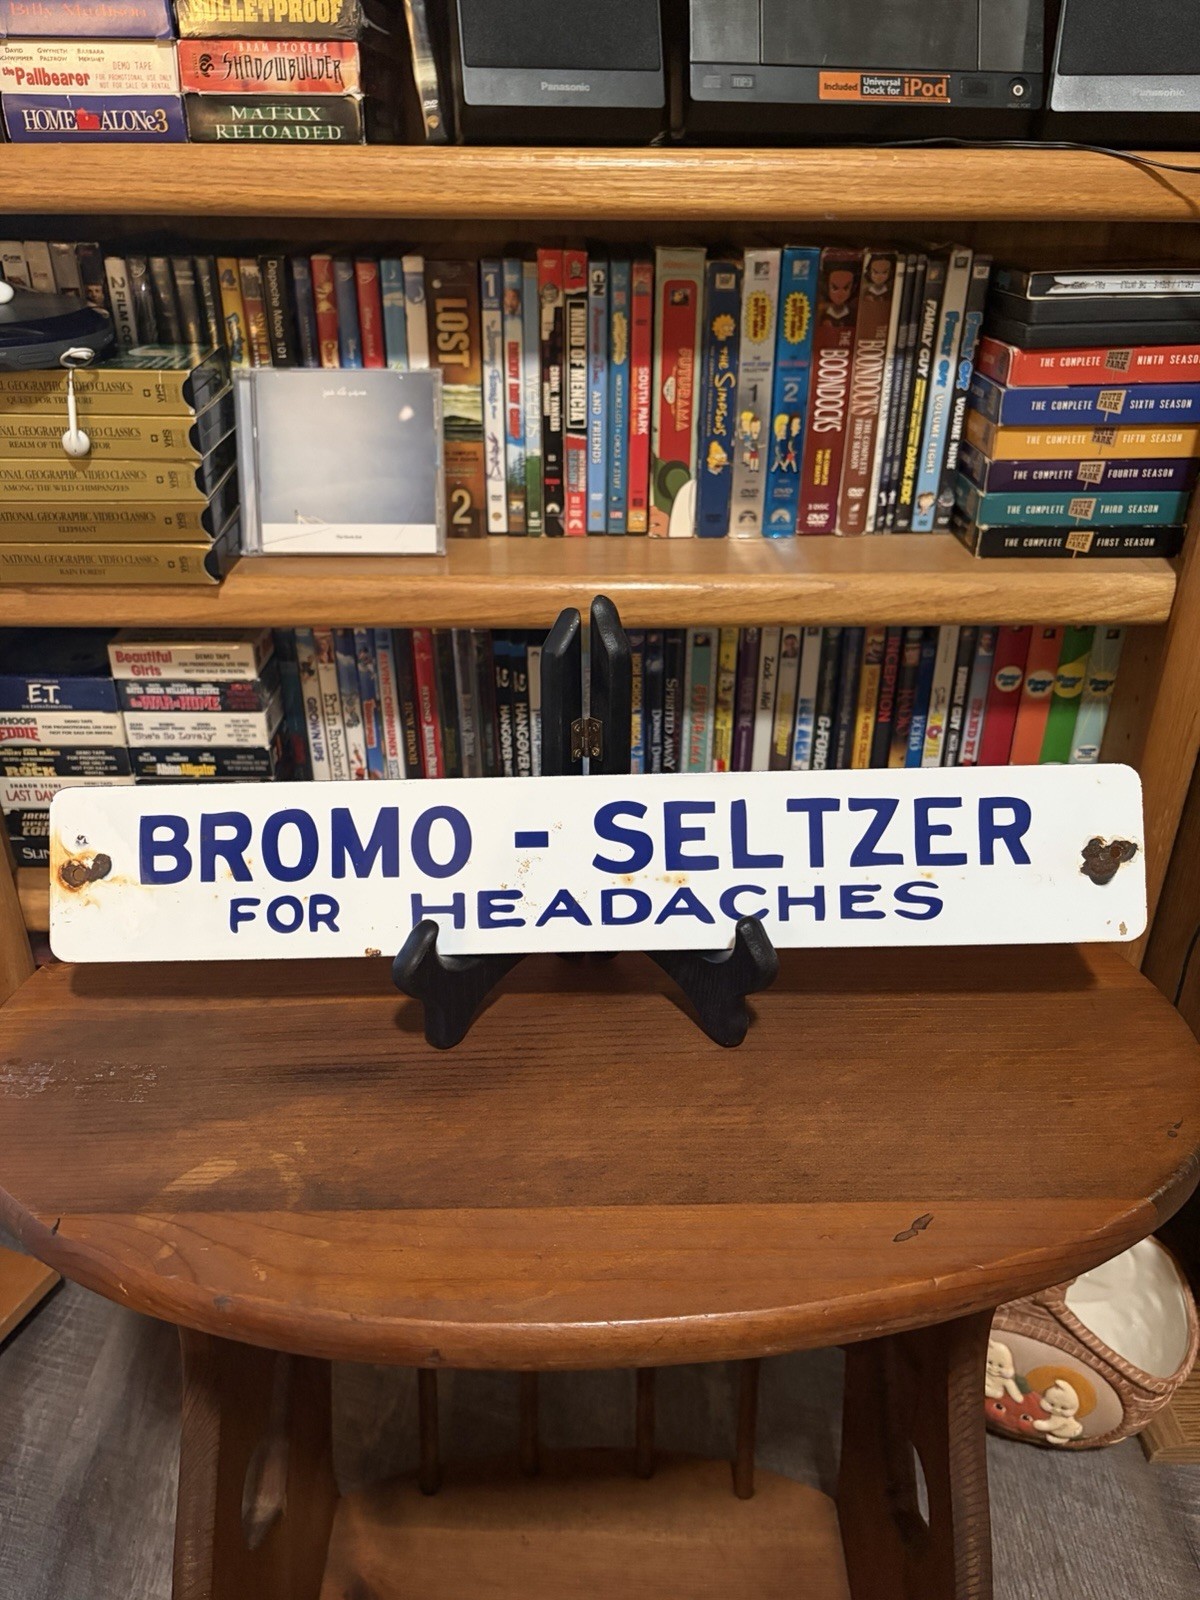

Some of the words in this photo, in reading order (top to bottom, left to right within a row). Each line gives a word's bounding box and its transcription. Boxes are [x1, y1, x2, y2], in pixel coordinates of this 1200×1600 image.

[2, 66, 15, 76] the
[14, 66, 90, 86] Pallbearer
[112, 61, 131, 71] DEMO
[134, 61, 153, 71] TAPE
[221, 50, 346, 91] SHADOWBUILDER
[540, 81, 591, 93] Panasonic
[823, 82, 859, 92] Included
[862, 77, 902, 87] Universal
[862, 86, 885, 96] Dock
[886, 86, 901, 96] for
[903, 77, 948, 97] iPod
[22, 109, 78, 131] HOME
[230, 105, 322, 122] MATRIX
[215, 124, 345, 141] RELOADED
[267, 259, 281, 307] Depeche
[273, 308, 286, 339] Mode
[435, 298, 471, 369] LOST
[569, 308, 586, 347] MIND
[921, 299, 938, 350] FAMILY
[838, 330, 852, 347] THE
[276, 342, 288, 360] 101
[569, 348, 586, 368] OF
[718, 346, 730, 371] THE
[1040, 357, 1055, 368] THE
[1060, 356, 1101, 367] COMPLETE
[1137, 355, 1165, 366] NINTH
[1169, 354, 1200, 365] SEASO
[916, 349, 930, 379] GUY
[7, 380, 65, 392] GEOGRAPHIC
[95, 380, 133, 392] CLASSICS
[637, 366, 650, 403] SOUTH
[851, 338, 887, 417] BOONDOCKS
[155, 383, 168, 403] VHS
[569, 368, 586, 423] MENCIA
[674, 347, 694, 432] FUTURAMA
[748, 383, 758, 403] 1
[783, 382, 800, 403] 2
[812, 348, 850, 433] BOONDOCKS
[591, 391, 603, 415] AND
[1031, 401, 1046, 411] THE
[1051, 400, 1093, 411] COMPLETE
[1130, 400, 1156, 410] SIXTH
[1159, 399, 1193, 409] SEASON
[636, 405, 649, 436] PARK
[929, 394, 946, 440] VOLUME
[950, 396, 967, 441] VOLUME
[104, 426, 141, 437] CLASSICS
[162, 429, 175, 448] VHS
[591, 420, 602, 465] FRIENDS
[1026, 435, 1040, 445] THE
[1046, 435, 1087, 445] COMPLETE
[1122, 434, 1147, 444] FIFTH
[1150, 433, 1184, 443] SEASON
[904, 445, 917, 477] DARK
[925, 440, 938, 475] EIGHT
[946, 441, 959, 471] NINE
[25, 469, 81, 479] GEOGRAPHIC
[82, 469, 110, 479] VIDEO
[110, 469, 148, 480] CLASSICS
[168, 470, 180, 489] VHS
[1013, 470, 1028, 480] THE
[1032, 470, 1074, 480] COMPLETE
[1107, 469, 1140, 479] FOURTH
[1141, 468, 1175, 478] SEASON
[3, 484, 35, 492] AMONG
[37, 484, 51, 492] THE
[53, 484, 76, 492] WILD
[76, 484, 131, 493] CHIMPANZEES
[900, 476, 913, 506] SIDE
[37, 511, 92, 522] GEOGRAPHIC
[93, 511, 120, 522] VIDEO
[120, 511, 157, 522] CLASSICS
[450, 488, 474, 526] 2
[1007, 505, 1021, 515] THE
[1025, 505, 1065, 515] COMPLETE
[1100, 504, 1124, 514] THIRD
[1127, 504, 1160, 514] SEASON
[58, 525, 98, 534] ELEPHANT
[176, 511, 188, 530] VHS
[1004, 538, 1019, 548] THE
[1023, 538, 1063, 548] COMPLETE
[1096, 537, 1120, 548] FIRST
[1123, 537, 1156, 548] SEASON
[2, 554, 44, 565] NATIONAL
[44, 554, 95, 565] GEOGRAPHIC
[96, 554, 124, 565] VIDEO
[115, 650, 173, 663] Beautiful
[131, 664, 162, 677] Girls
[879, 636, 902, 723] INCEPTION
[27, 683, 61, 704] E.T.
[953, 666, 969, 706] FAMILY
[323, 693, 341, 727] Erin
[664, 678, 678, 735] SPIRITED
[306, 697, 321, 740] GROWN
[384, 696, 399, 758] CHIPMUNKS
[690, 683, 708, 765] FUTURAMA
[949, 705, 963, 731] GUY
[0, 726, 41, 743] EDDIE
[500, 704, 513, 760] HANGOVER
[515, 702, 531, 771] HANGOVER
[812, 715, 831, 770] G-FORC
[310, 740, 325, 763] UPS
[663, 735, 676, 771] AWAY
[5, 765, 57, 777] ROCK
[5, 790, 32, 802] LAST
[138, 804, 473, 886] BROMO
[514, 830, 550, 849] -
[591, 796, 1033, 874] SELTZER
[229, 893, 341, 934] FOR
[411, 881, 943, 930] HEADACHES
